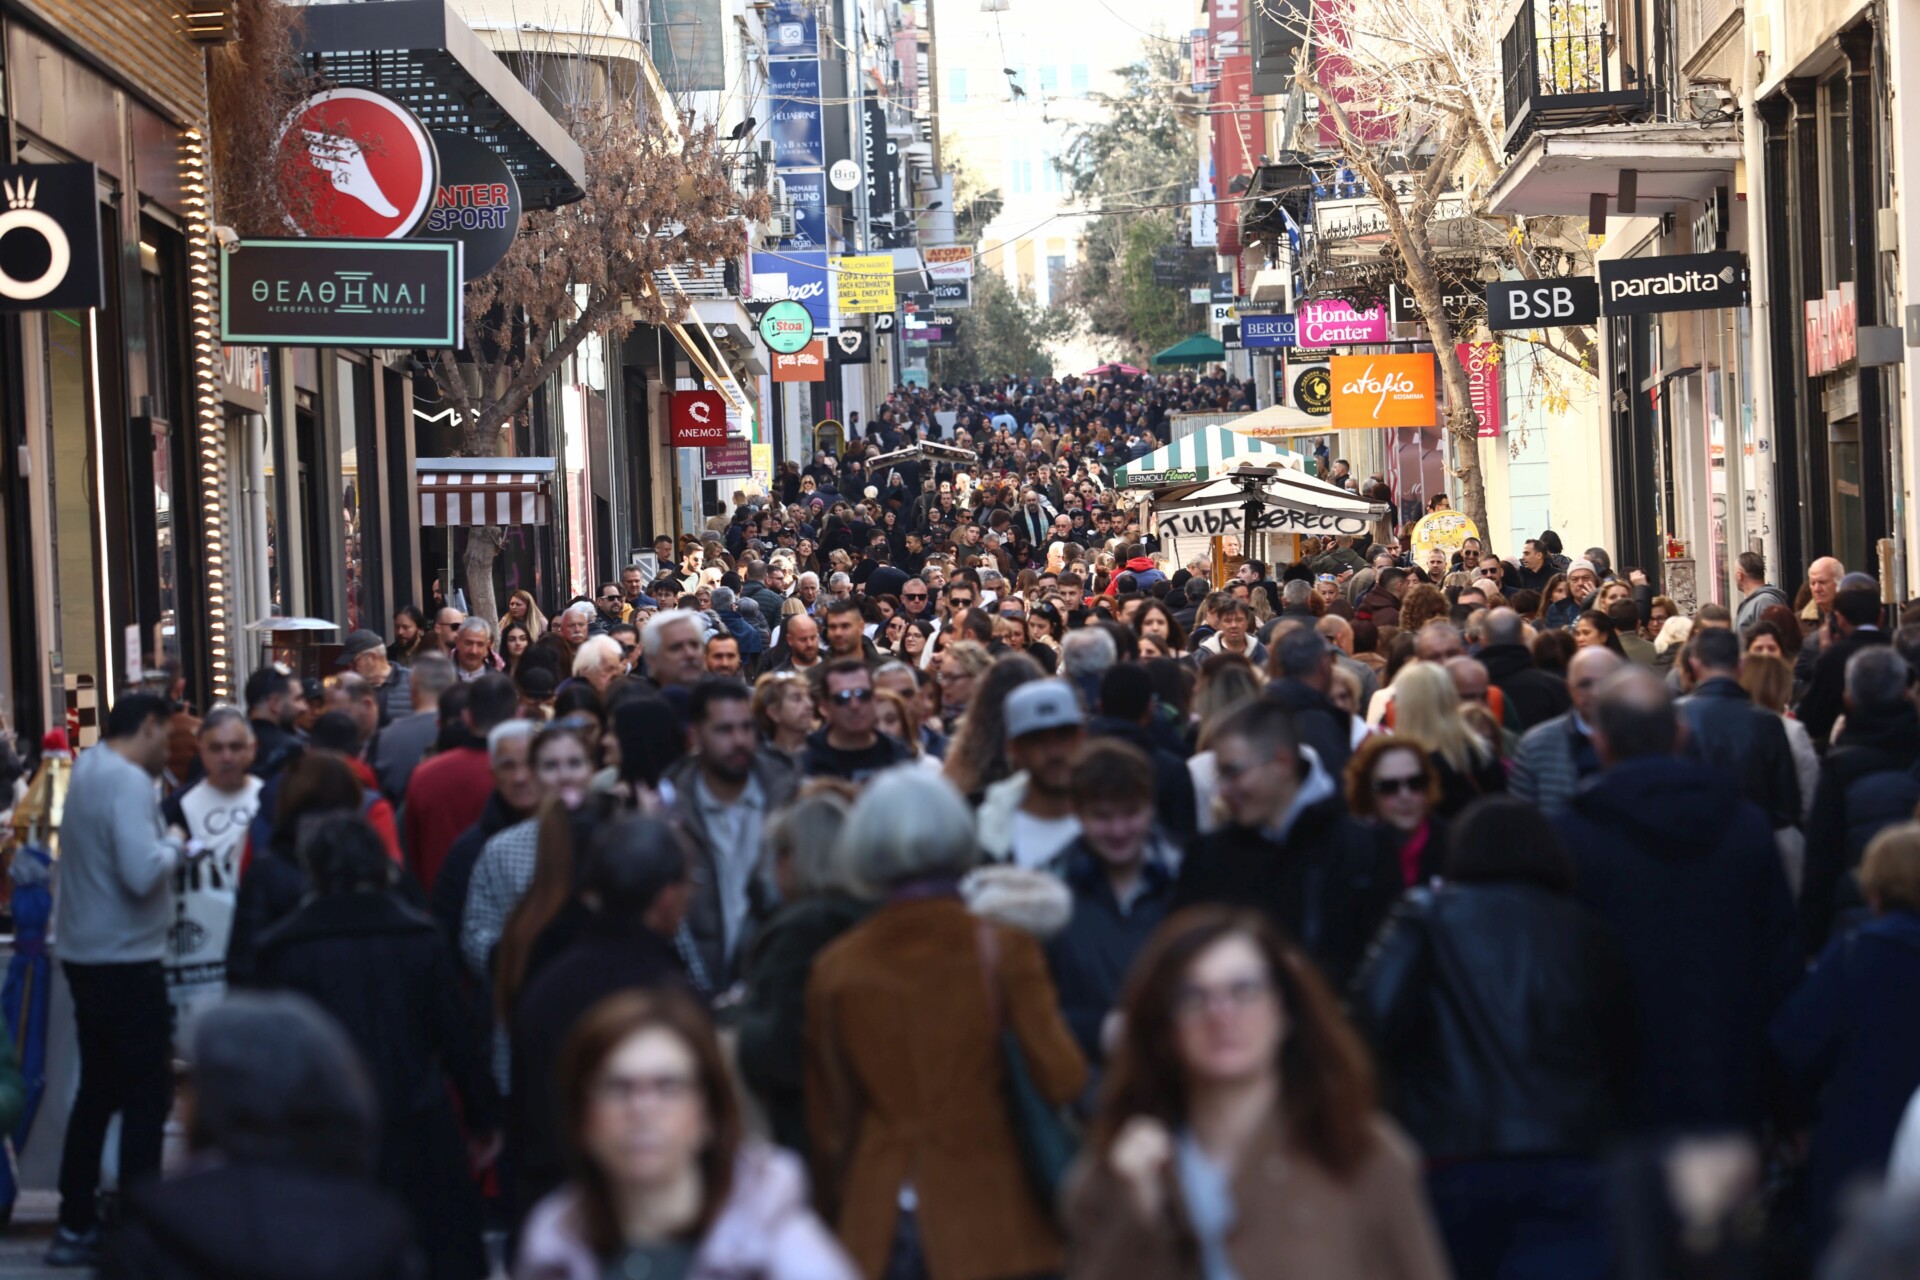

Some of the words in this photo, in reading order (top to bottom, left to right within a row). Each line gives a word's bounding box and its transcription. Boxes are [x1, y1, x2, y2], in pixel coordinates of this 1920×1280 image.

[772, 81, 816, 90] nordgreen
[437, 183, 509, 208] NTER
[792, 192, 820, 201] RLIND
[429, 206, 510, 231] SPORT
[788, 280, 825, 300] rex
[839, 290, 857, 298] ΑΝΕΙΑ
[1611, 270, 1718, 302] parabita
[1403, 294, 1479, 309] DRTE
[1509, 287, 1575, 320] BSB
[1306, 305, 1379, 324] Hondos
[1306, 323, 1372, 342] Center
[678, 428, 723, 438] ΑΝΕΜΟΣ
[1128, 474, 1163, 483] ERMOU
[1164, 469, 1195, 481] Flower
